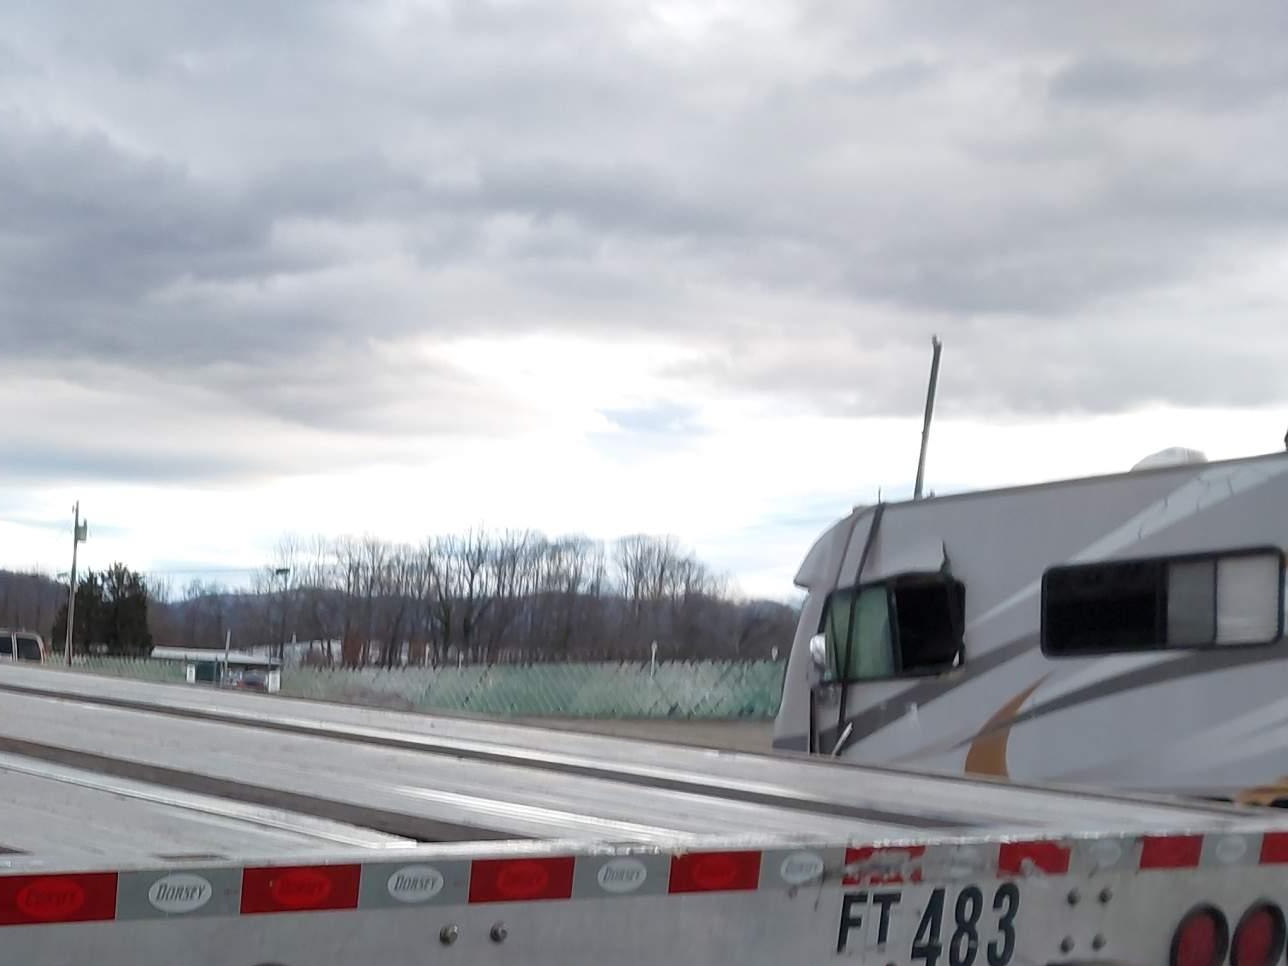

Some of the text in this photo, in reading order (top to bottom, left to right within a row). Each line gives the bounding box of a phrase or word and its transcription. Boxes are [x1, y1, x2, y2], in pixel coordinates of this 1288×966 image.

[155, 878, 207, 902] DORSEY
[393, 869, 437, 891] DORSEY
[836, 892, 902, 954] FT
